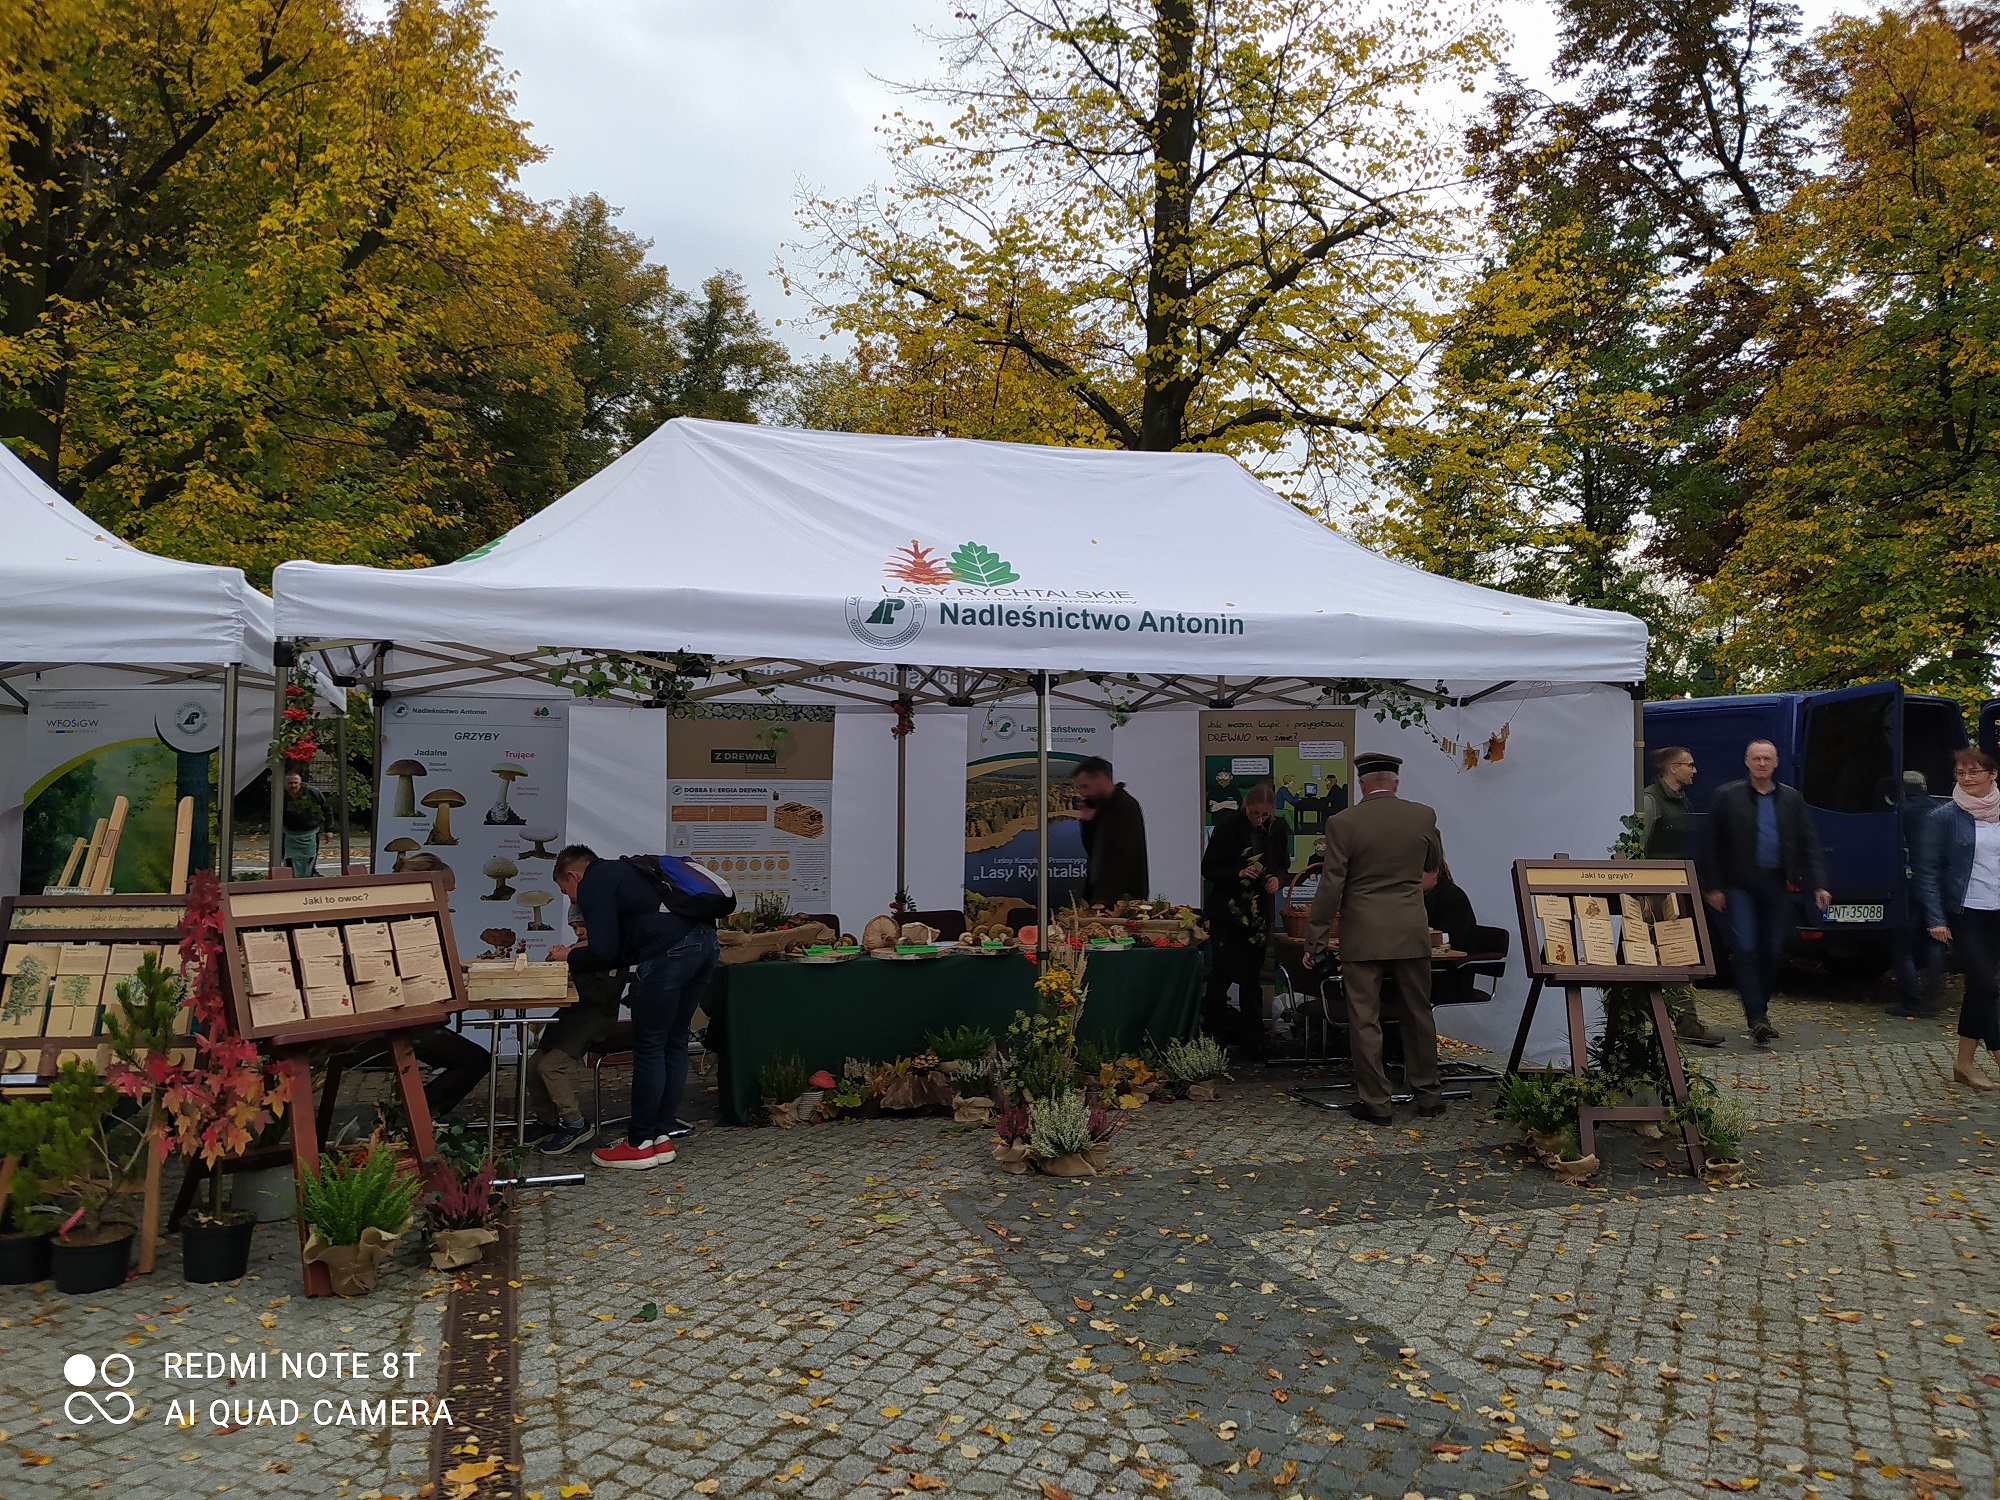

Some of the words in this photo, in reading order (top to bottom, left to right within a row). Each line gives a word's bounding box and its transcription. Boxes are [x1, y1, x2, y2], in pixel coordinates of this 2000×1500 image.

[881, 584, 948, 596] LASY
[957, 587, 1135, 600] RYCHTALSKIE
[939, 602, 1131, 632] Nadleśnictwo
[1138, 608, 1245, 636] Antonin
[412, 706, 459, 716] Nadleśnictwo
[459, 707, 488, 716] Antonin
[1050, 723, 1097, 734] aństwowe
[454, 731, 500, 742] GRZYBY
[1207, 732, 1252, 742] DREWNO
[414, 748, 448, 758] Jadalne
[504, 750, 535, 761] Trujące
[714, 752, 722, 761] Z
[1579, 871, 1597, 880] Jaki
[1598, 872, 1606, 880] to
[1607, 872, 1634, 881] grzyb?
[302, 897, 323, 906] Jaki
[325, 897, 336, 905] to
[338, 892, 370, 904] owoc?
[108, 913, 116, 922] to
[1850, 905, 1883, 919] 35088
